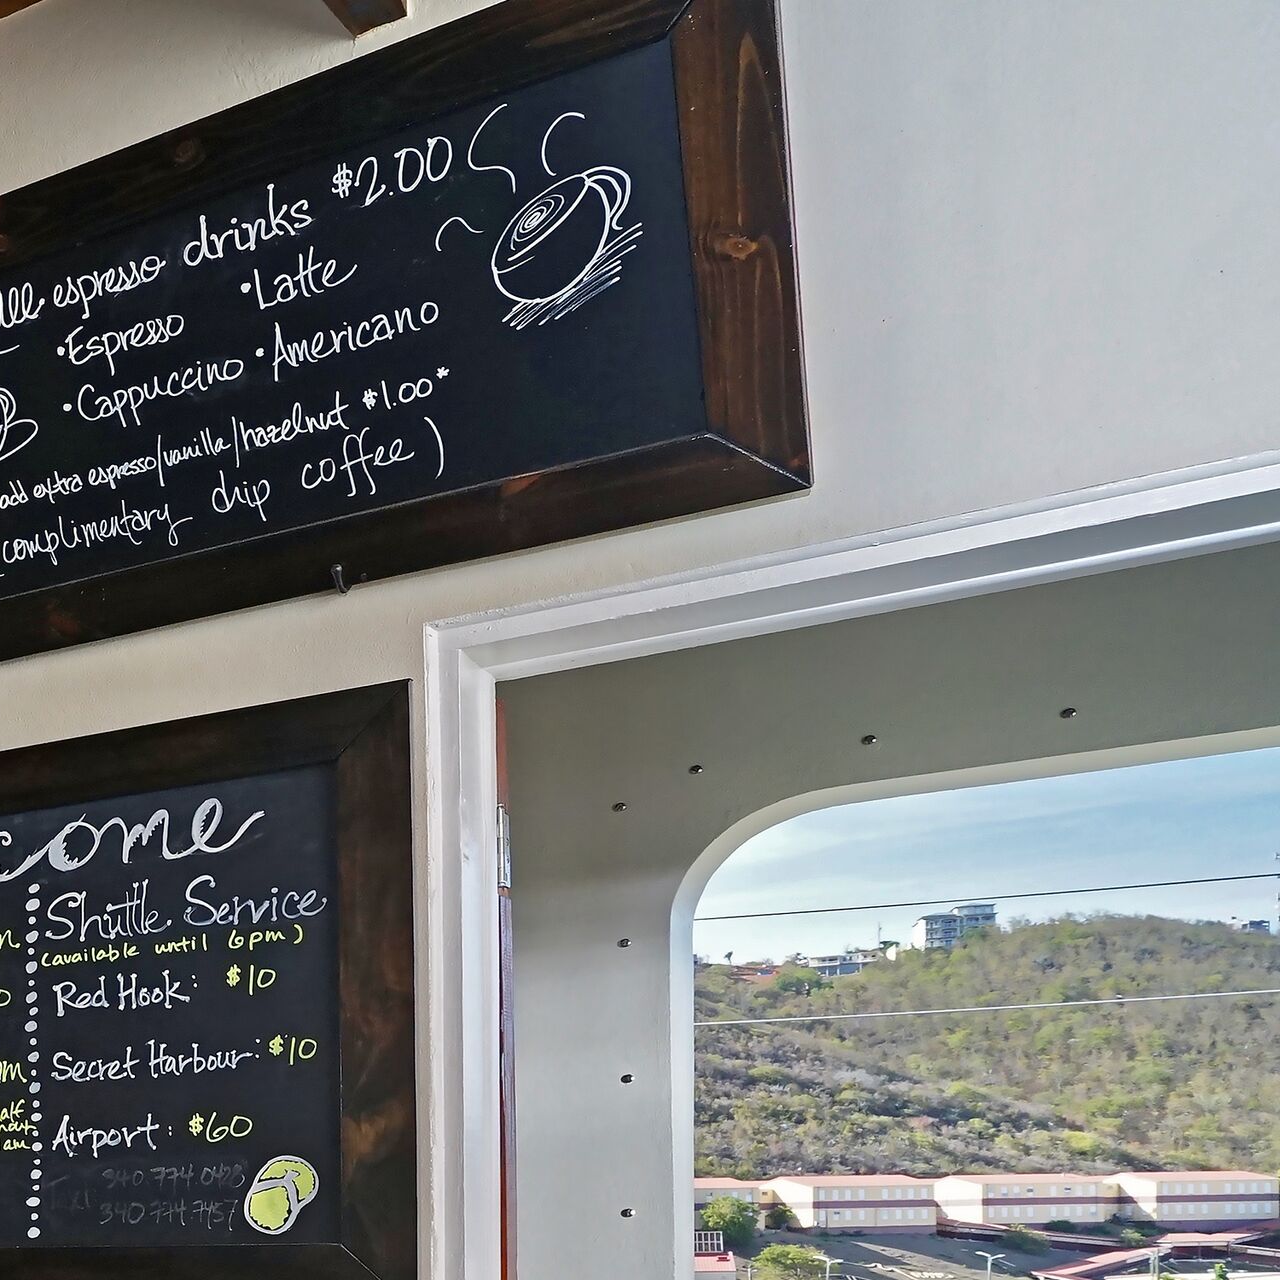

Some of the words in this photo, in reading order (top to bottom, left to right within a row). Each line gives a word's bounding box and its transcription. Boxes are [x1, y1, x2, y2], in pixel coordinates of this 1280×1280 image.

[52, 254, 166, 319] espresso
[183, 183, 313, 267] drinks
[331, 136, 452, 209] $2.00
[64, 313, 185, 376] Espresso
[254, 245, 359, 310] Latte
[77, 356, 244, 427] Cappuccino
[271, 301, 440, 382] Americano
[33, 470, 83, 503] extra
[211, 470, 271, 521] drip
[44, 879, 173, 942] Shuttle
[184, 874, 328, 926] Service
[154, 933, 208, 955] until
[51, 975, 110, 1017] Red
[226, 963, 277, 997] $10
[51, 1045, 140, 1083] Secret
[268, 1034, 318, 1066] $10
[188, 1111, 253, 1143] $60
